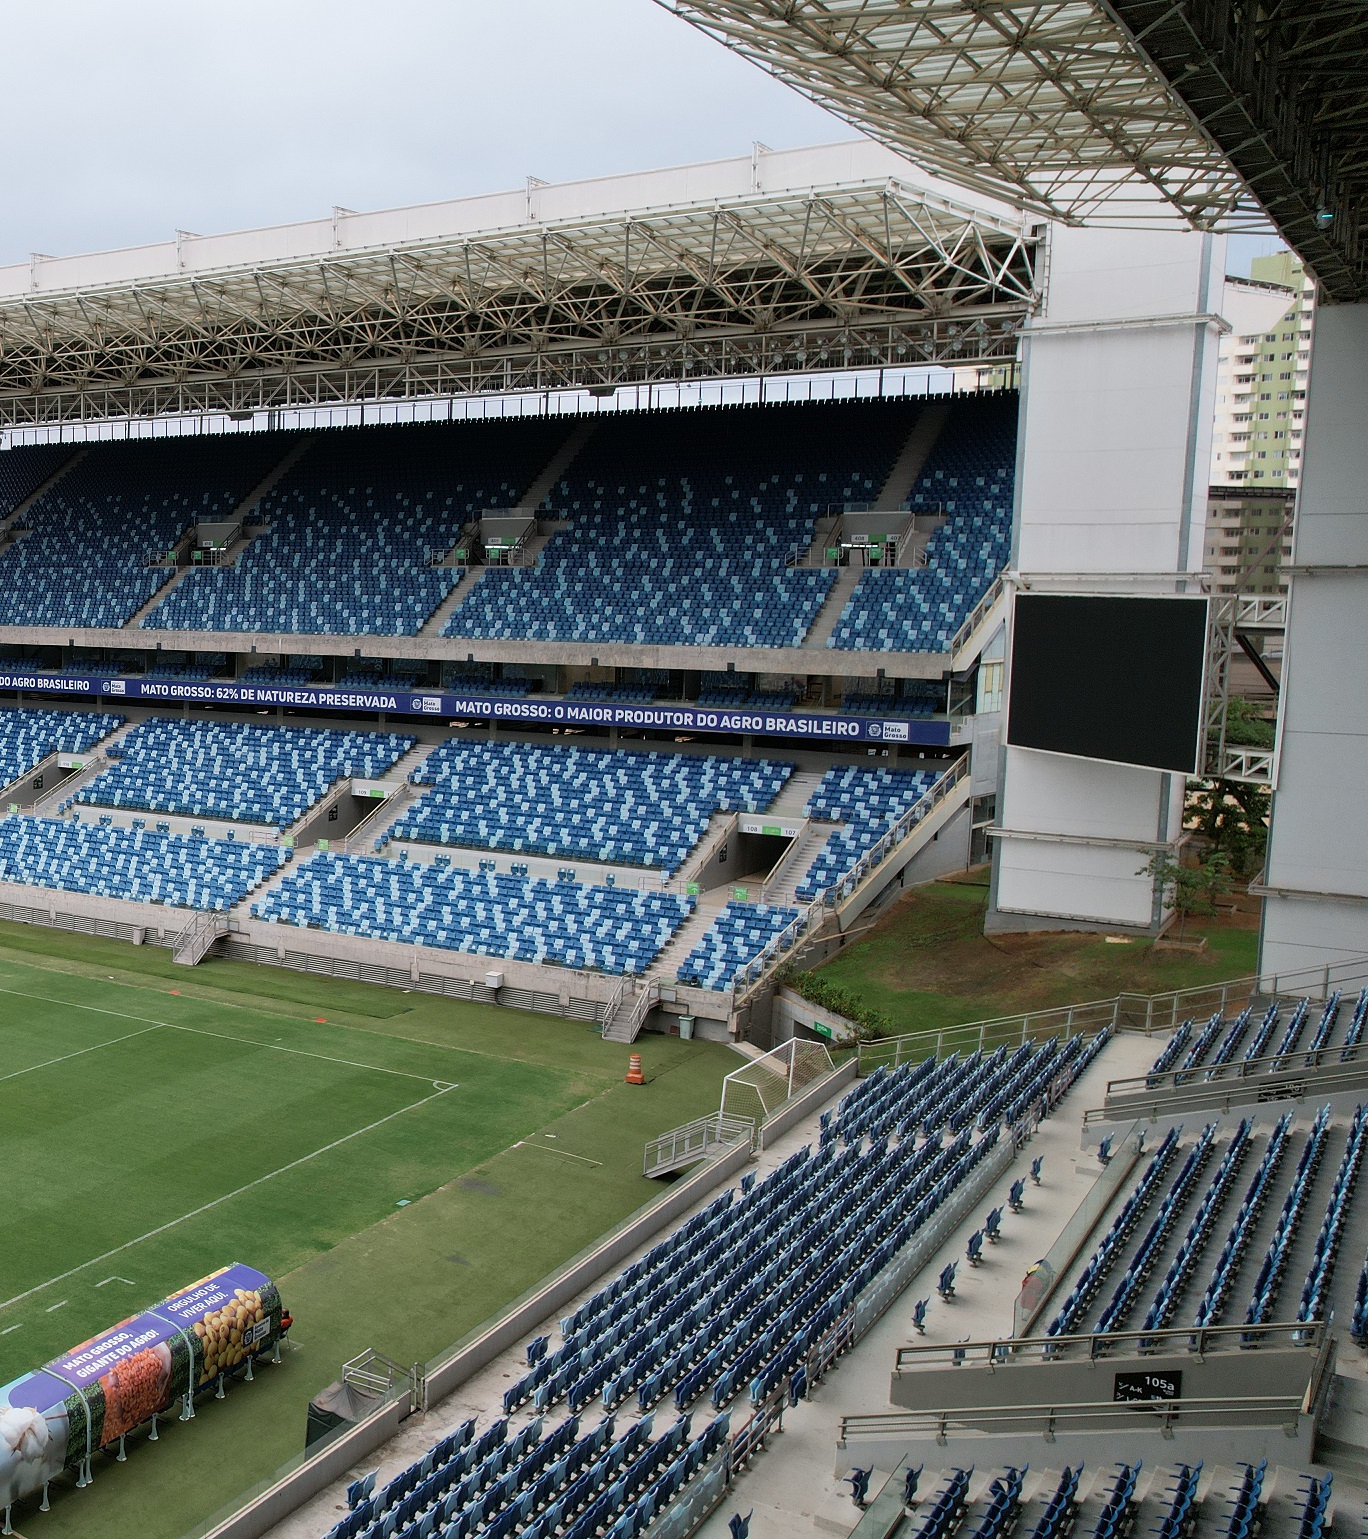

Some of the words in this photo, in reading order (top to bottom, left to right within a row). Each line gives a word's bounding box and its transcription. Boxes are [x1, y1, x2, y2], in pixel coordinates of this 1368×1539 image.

[12, 676, 36, 688] AGRO
[37, 678, 90, 691] BRASILEIRO
[140, 683, 169, 695] MATO
[170, 685, 215, 698] GROSSO:
[216, 687, 239, 700] 62%
[240, 688, 255, 701] DE
[256, 690, 317, 704] NATUREZA
[318, 693, 397, 709] PRESERVADA
[455, 700, 492, 714] MATO
[494, 703, 552, 718] GROSSO:
[554, 706, 564, 719] O
[567, 707, 613, 722] MAIOR
[615, 709, 694, 726] PRODUTOR
[696, 713, 718, 727] DO
[719, 715, 763, 730] AGRO
[765, 717, 860, 736] BRASILEIRO
[167, 1289, 209, 1312] ORGULHO
[205, 1283, 221, 1292] DE
[178, 1301, 207, 1319] VIVER
[206, 1291, 229, 1307] AQUI.
[62, 1353, 94, 1371] MATO
[90, 1332, 134, 1355] GROSSO,
[76, 1351, 120, 1378] GIGANTE
[114, 1344, 133, 1356] DO
[129, 1329, 160, 1349] AGRO!
[1144, 1376, 1175, 1391] 105a
